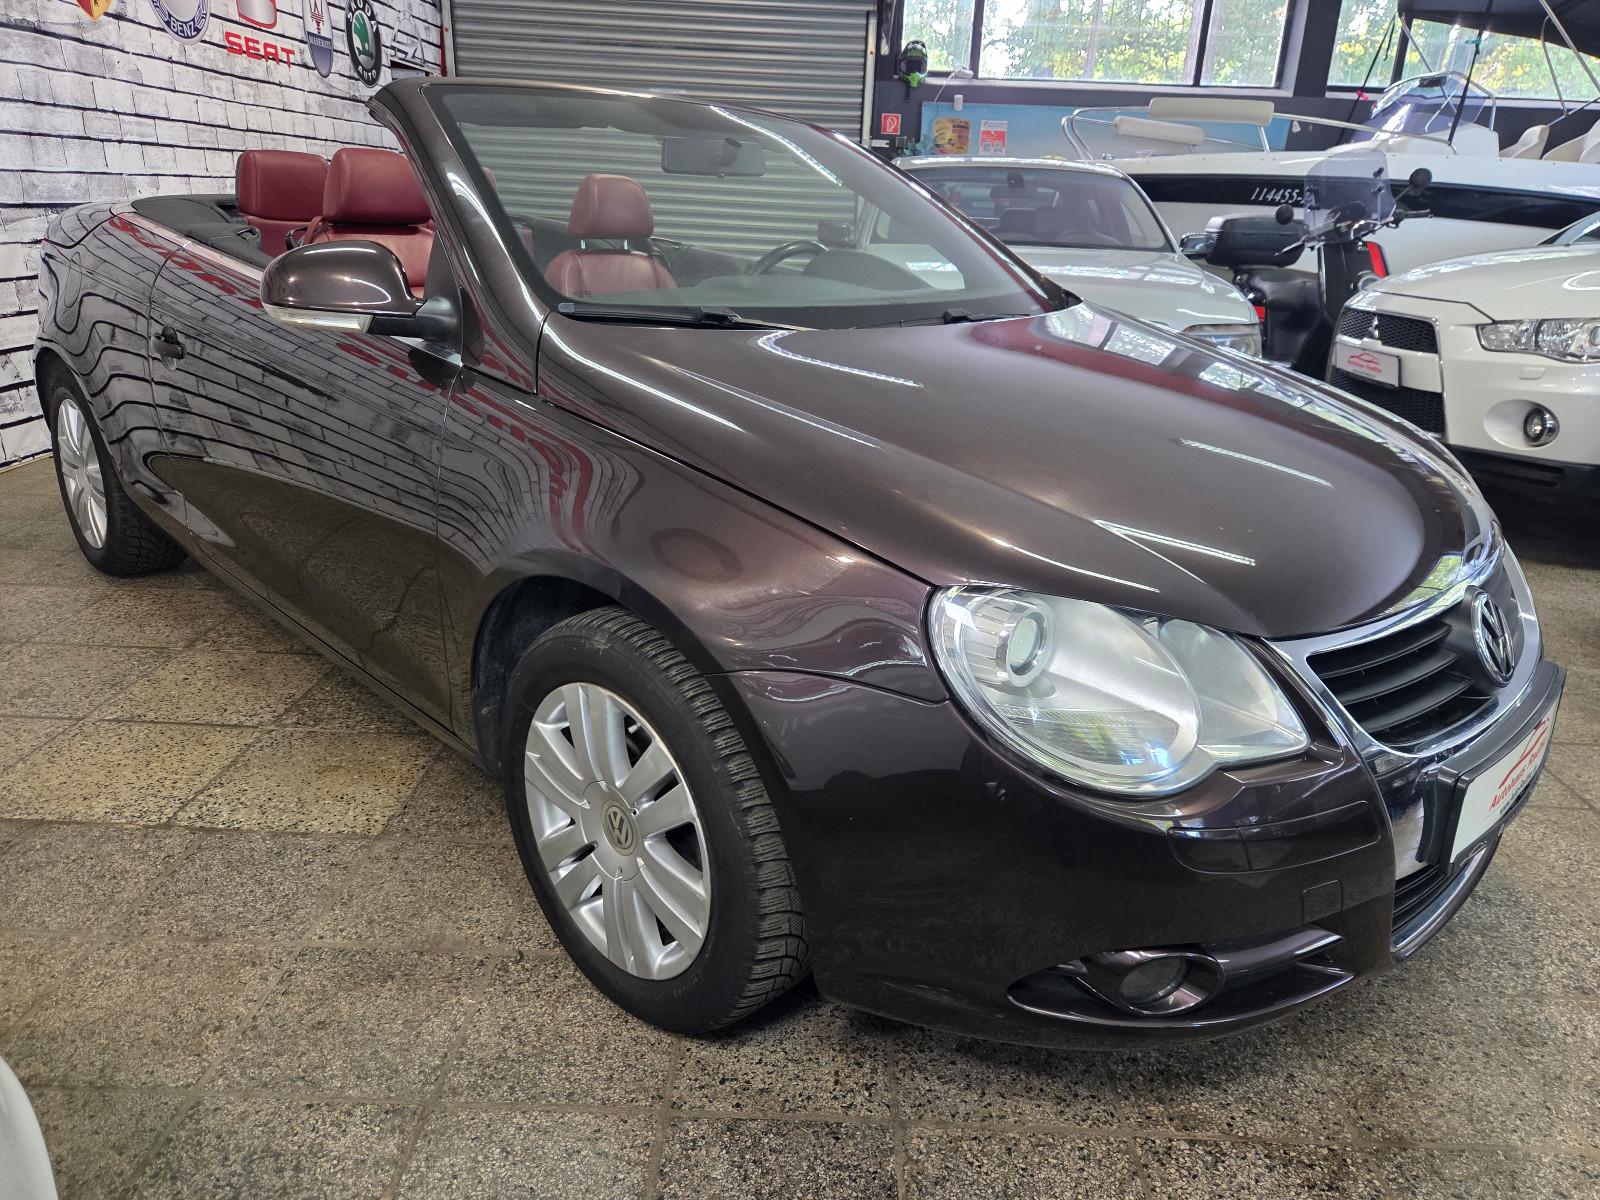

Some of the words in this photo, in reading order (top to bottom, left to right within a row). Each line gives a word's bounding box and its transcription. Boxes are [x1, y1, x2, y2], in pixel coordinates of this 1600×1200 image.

[170, 17, 198, 37] BENZ
[225, 31, 295, 68] SEAT
[358, 65, 377, 81] AUTO
